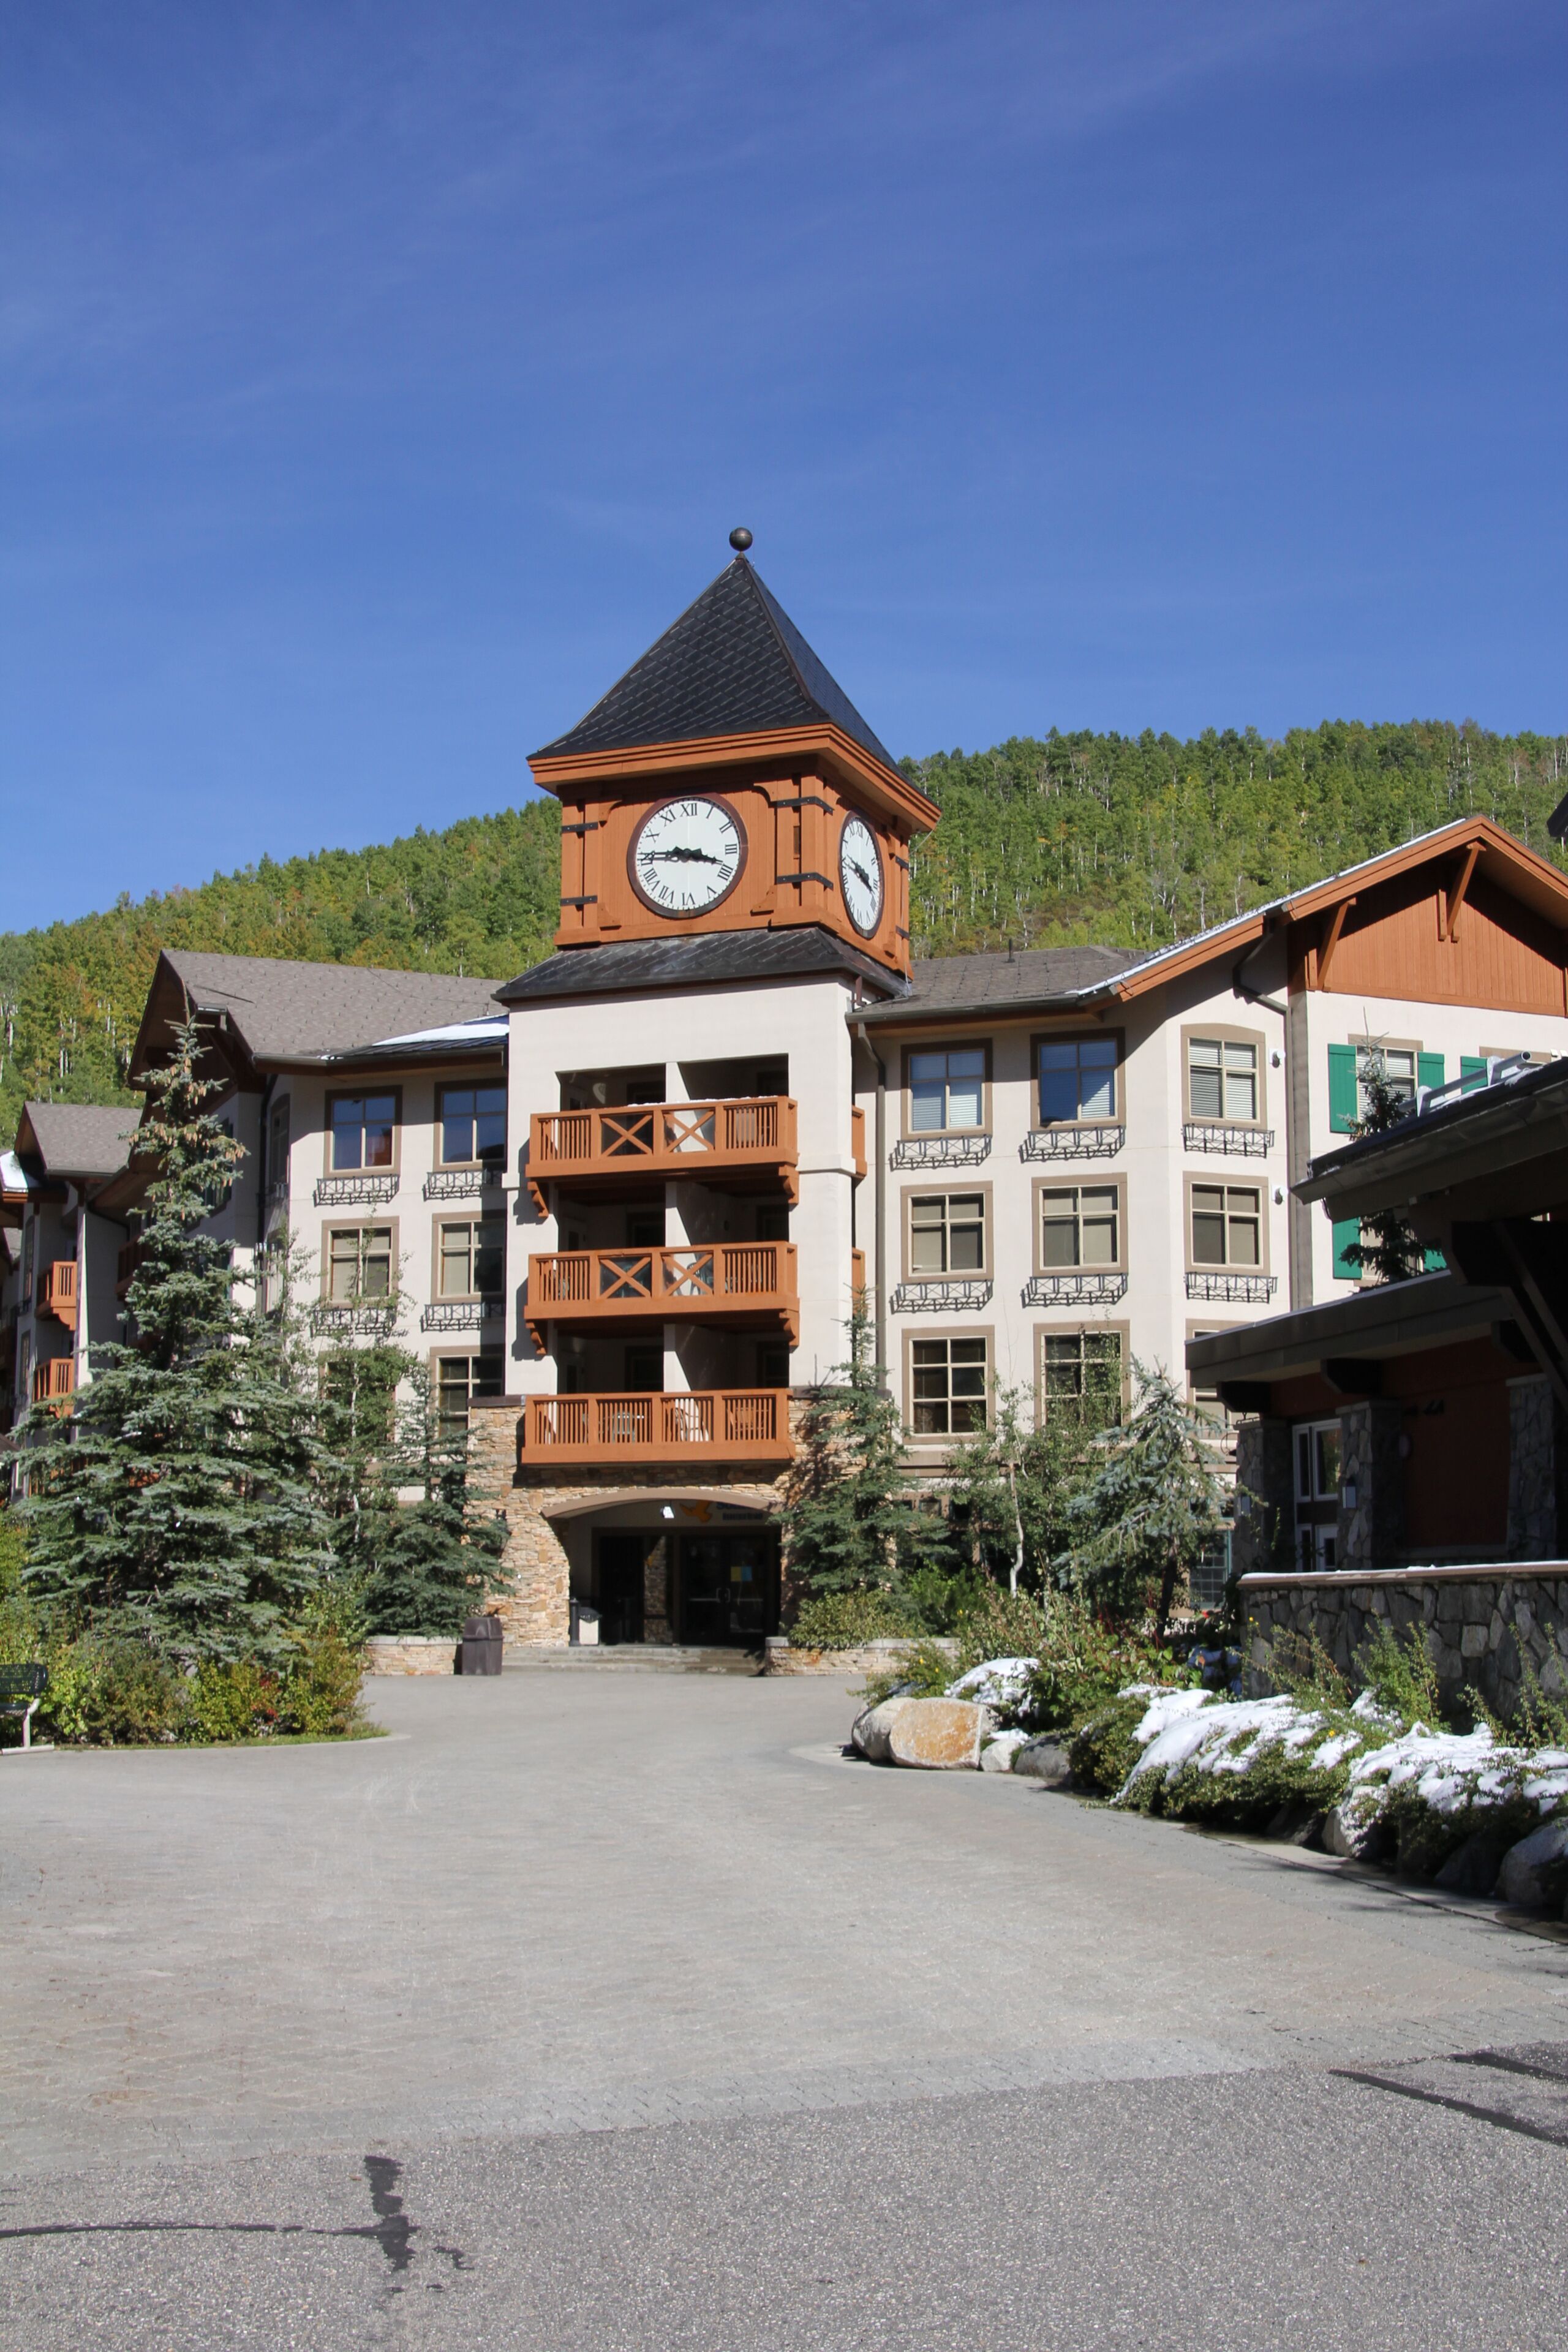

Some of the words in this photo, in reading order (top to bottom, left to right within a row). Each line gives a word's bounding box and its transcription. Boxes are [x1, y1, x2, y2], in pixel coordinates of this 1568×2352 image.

[680, 802, 698, 817] XII
[706, 806, 714, 819] I
[660, 809, 676, 827] XI
[719, 820, 733, 834] II
[645, 827, 660, 843] X
[725, 843, 737, 855] III
[643, 868, 661, 892] VIII
[717, 864, 734, 881] IIII
[658, 885, 674, 903] VII
[682, 892, 696, 906] VI
[706, 886, 717, 899] V
